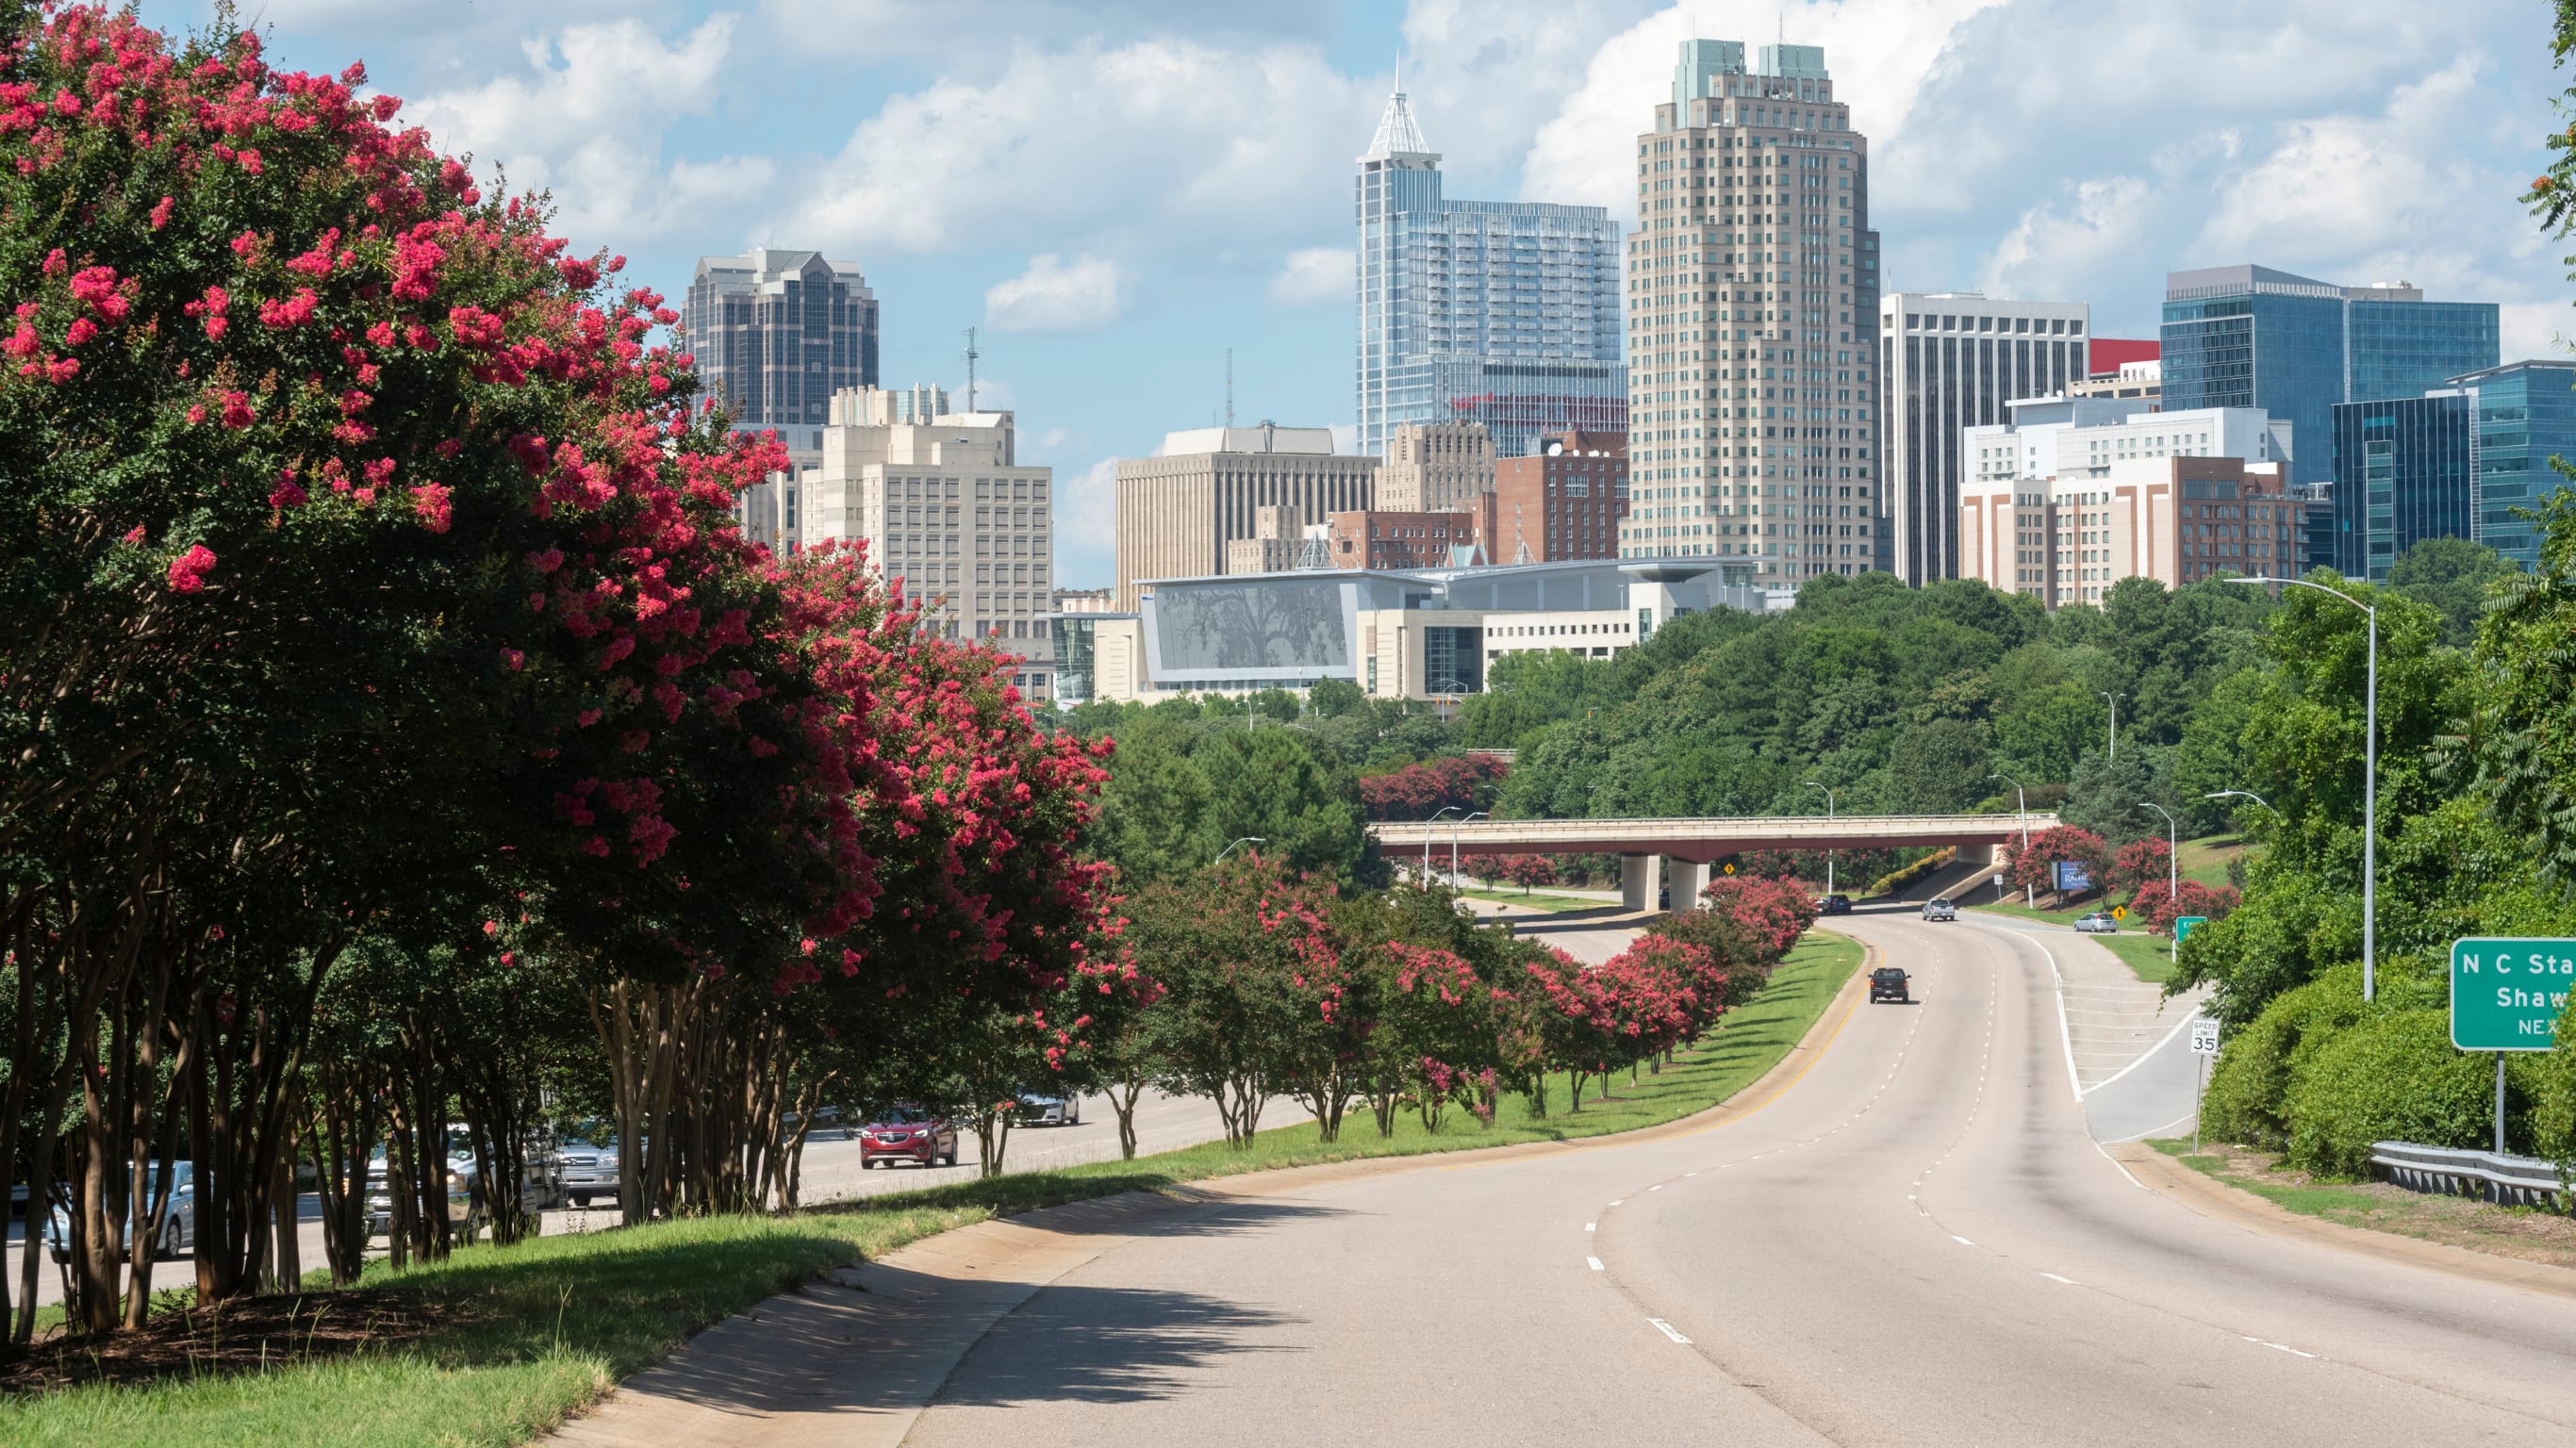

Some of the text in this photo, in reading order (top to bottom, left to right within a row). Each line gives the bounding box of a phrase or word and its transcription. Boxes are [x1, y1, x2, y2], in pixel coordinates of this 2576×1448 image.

[2463, 953, 2573, 974] N C Sta
[2497, 987, 2568, 1008] Shaw
[2194, 1022, 2218, 1030] SPEED
[2193, 1037, 2216, 1051] 35
